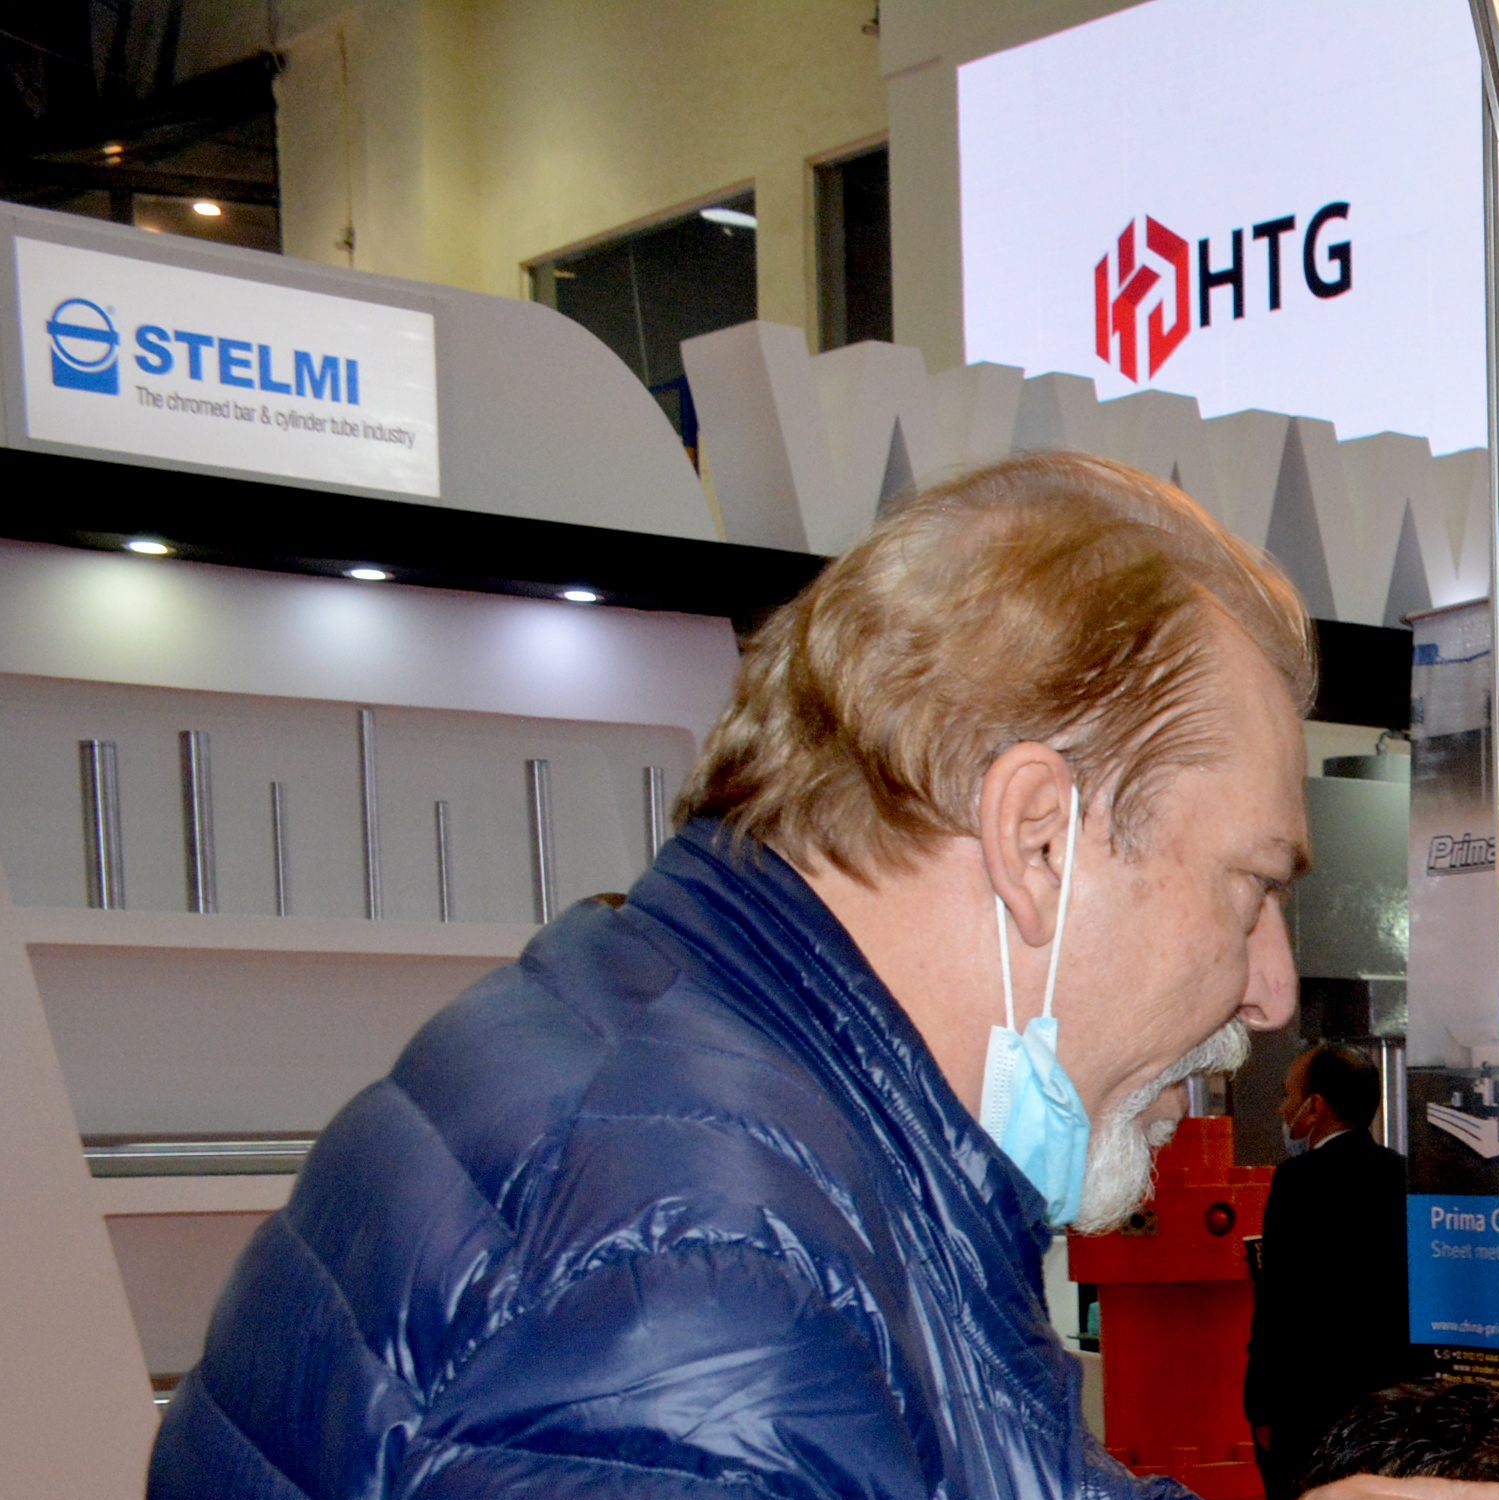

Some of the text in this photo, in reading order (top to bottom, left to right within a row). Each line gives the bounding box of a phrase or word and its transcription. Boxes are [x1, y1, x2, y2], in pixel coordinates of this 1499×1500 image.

[1198, 199, 1353, 329] HTG
[134, 324, 360, 406] STELMI
[135, 385, 416, 451] The chromed bar & cylinder tube industry
[1431, 1206, 1486, 1232] Prima
[1431, 1240, 1473, 1260] Sheet
